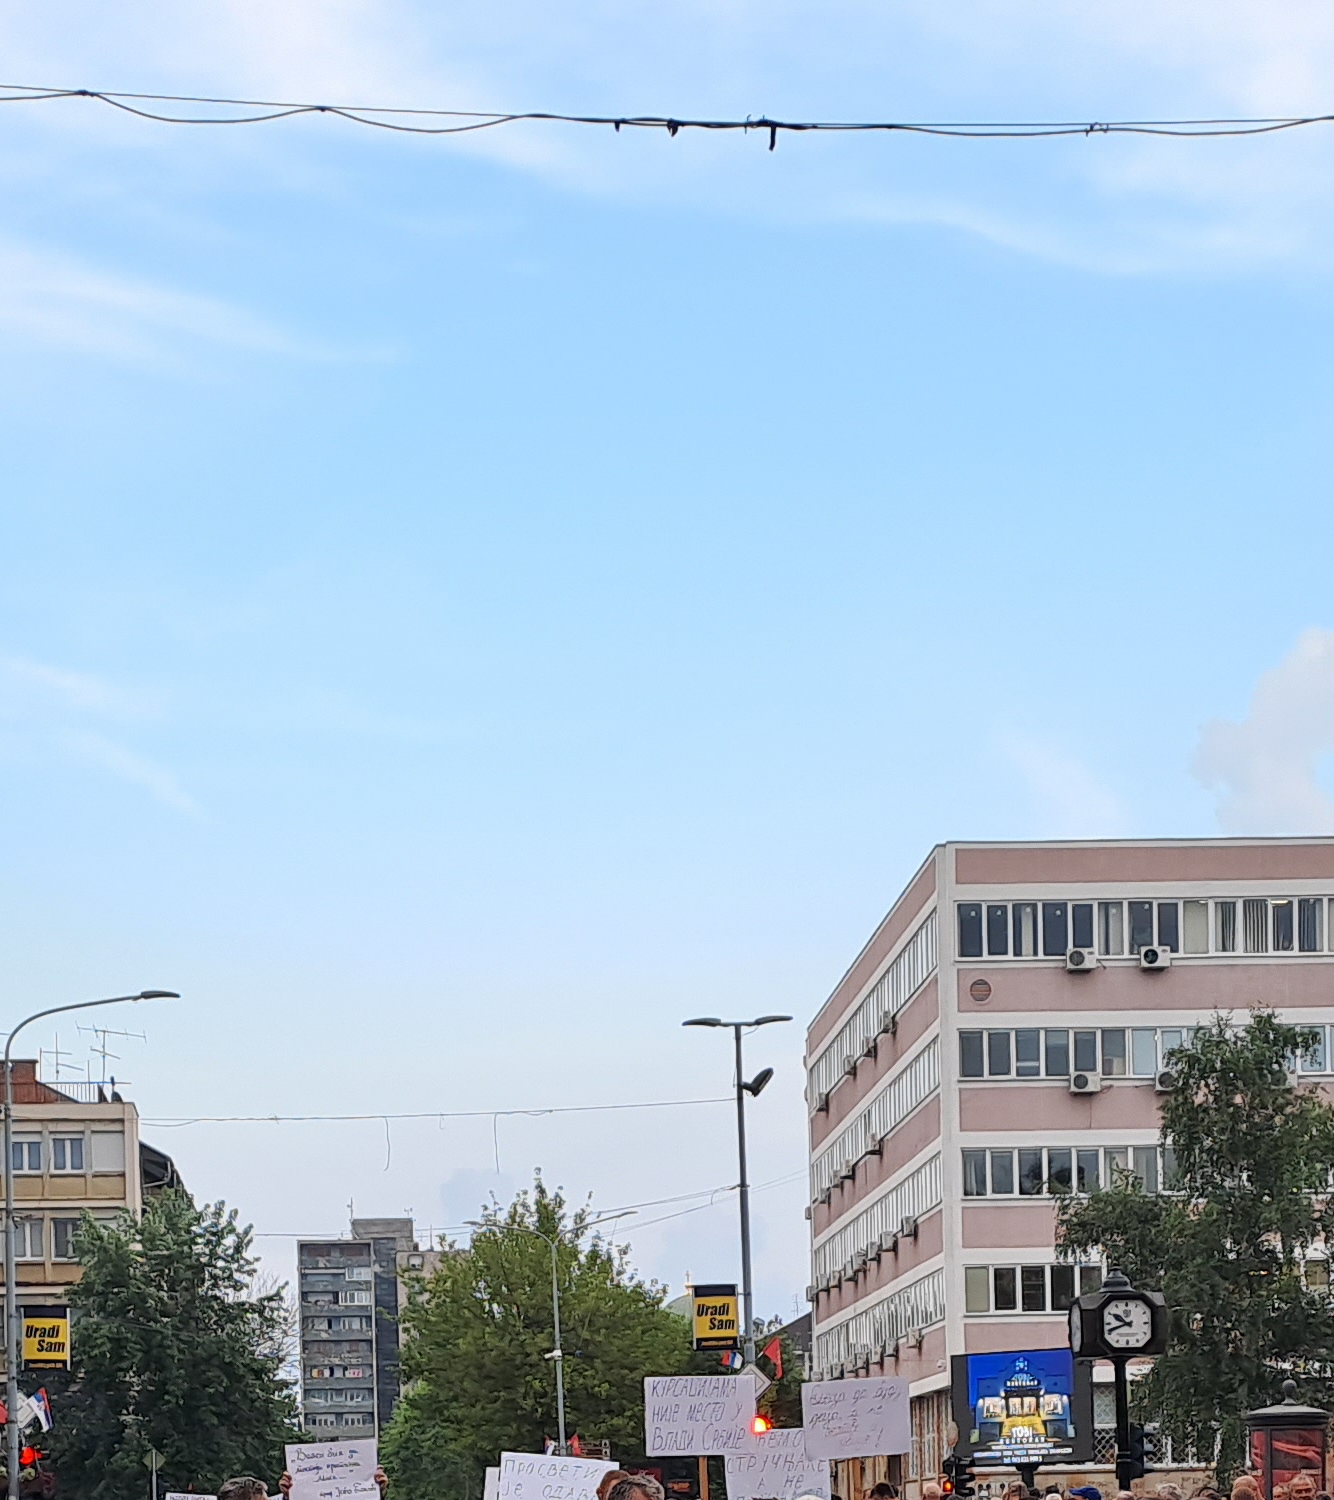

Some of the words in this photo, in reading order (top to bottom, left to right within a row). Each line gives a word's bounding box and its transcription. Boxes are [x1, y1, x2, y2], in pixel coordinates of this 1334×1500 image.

[696, 1302, 730, 1317] Uradi
[708, 1317, 736, 1330] Sam
[25, 1324, 61, 1338] Uradi
[36, 1339, 66, 1353] Sam
